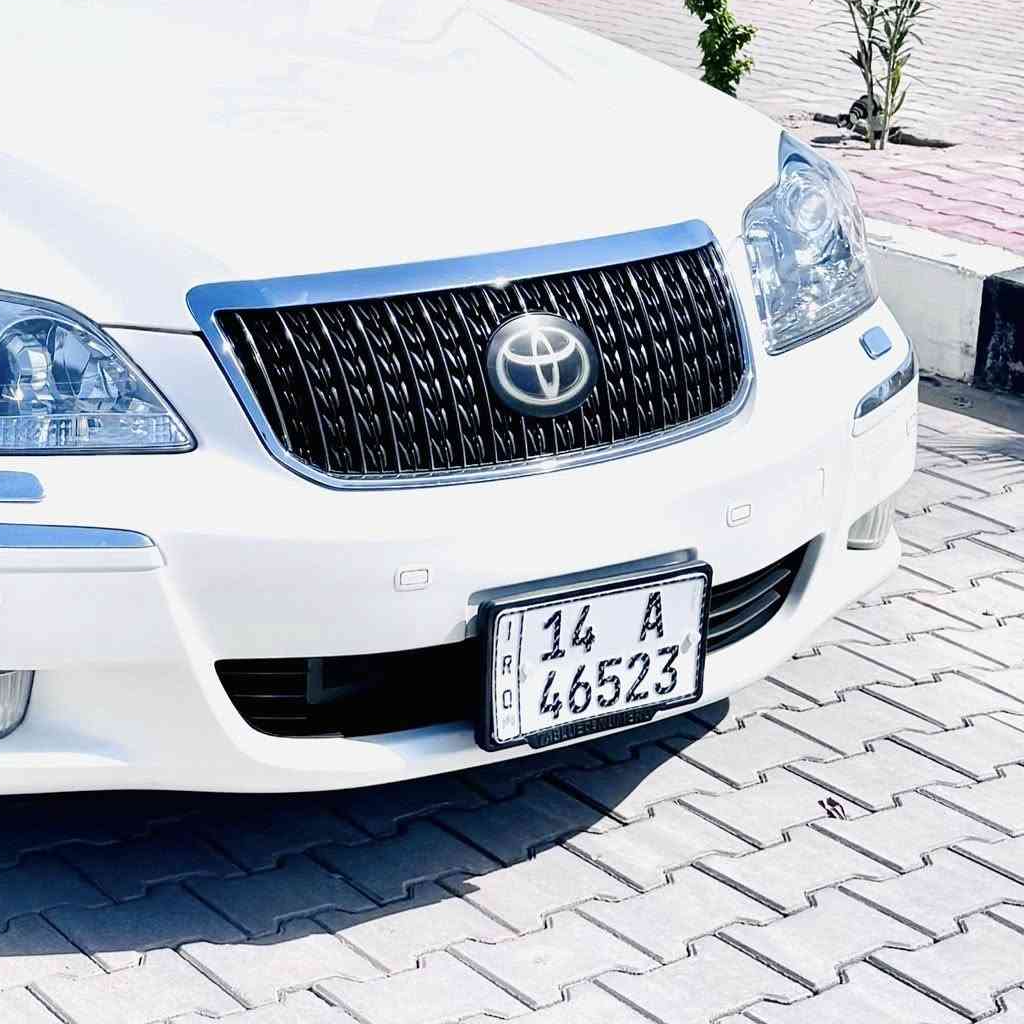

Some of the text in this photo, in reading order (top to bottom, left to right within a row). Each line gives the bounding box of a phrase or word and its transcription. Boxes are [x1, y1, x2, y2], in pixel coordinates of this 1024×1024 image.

[541, 591, 664, 661] 14 A
[540, 645, 679, 719] 46523
